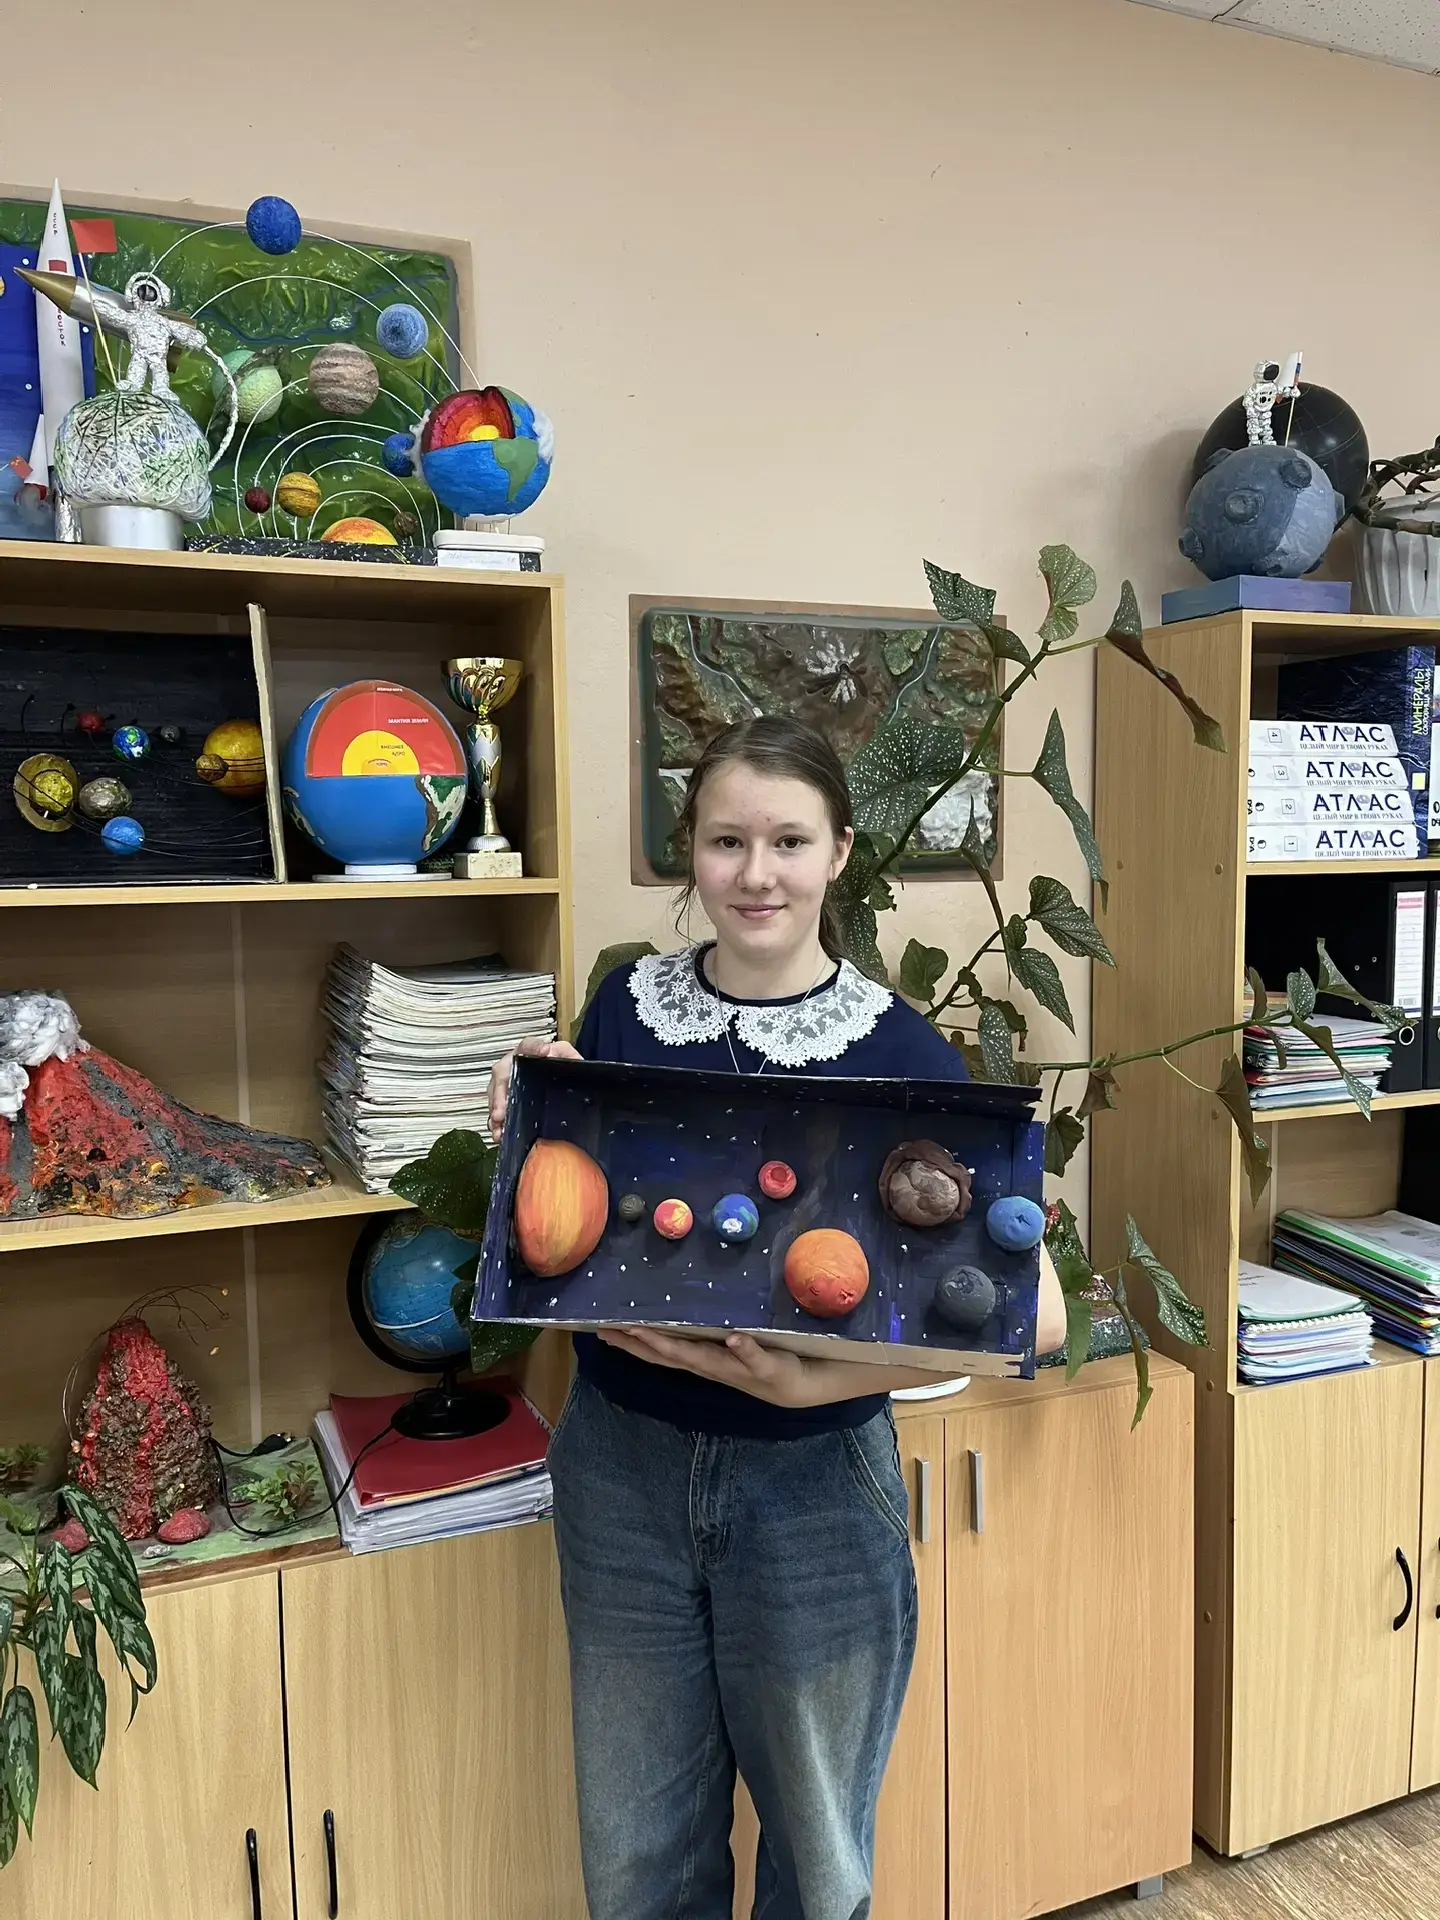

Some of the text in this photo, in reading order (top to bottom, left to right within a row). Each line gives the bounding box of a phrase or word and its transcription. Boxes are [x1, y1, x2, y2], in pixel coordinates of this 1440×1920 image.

[1412, 668, 1424, 735] МИНЕРАЛЫ
[1300, 724, 1386, 742] АТЛАС
[1306, 761, 1393, 778] АТЛАС
[1313, 793, 1401, 811] АТЛАС
[1316, 829, 1405, 849] АТЛАС
